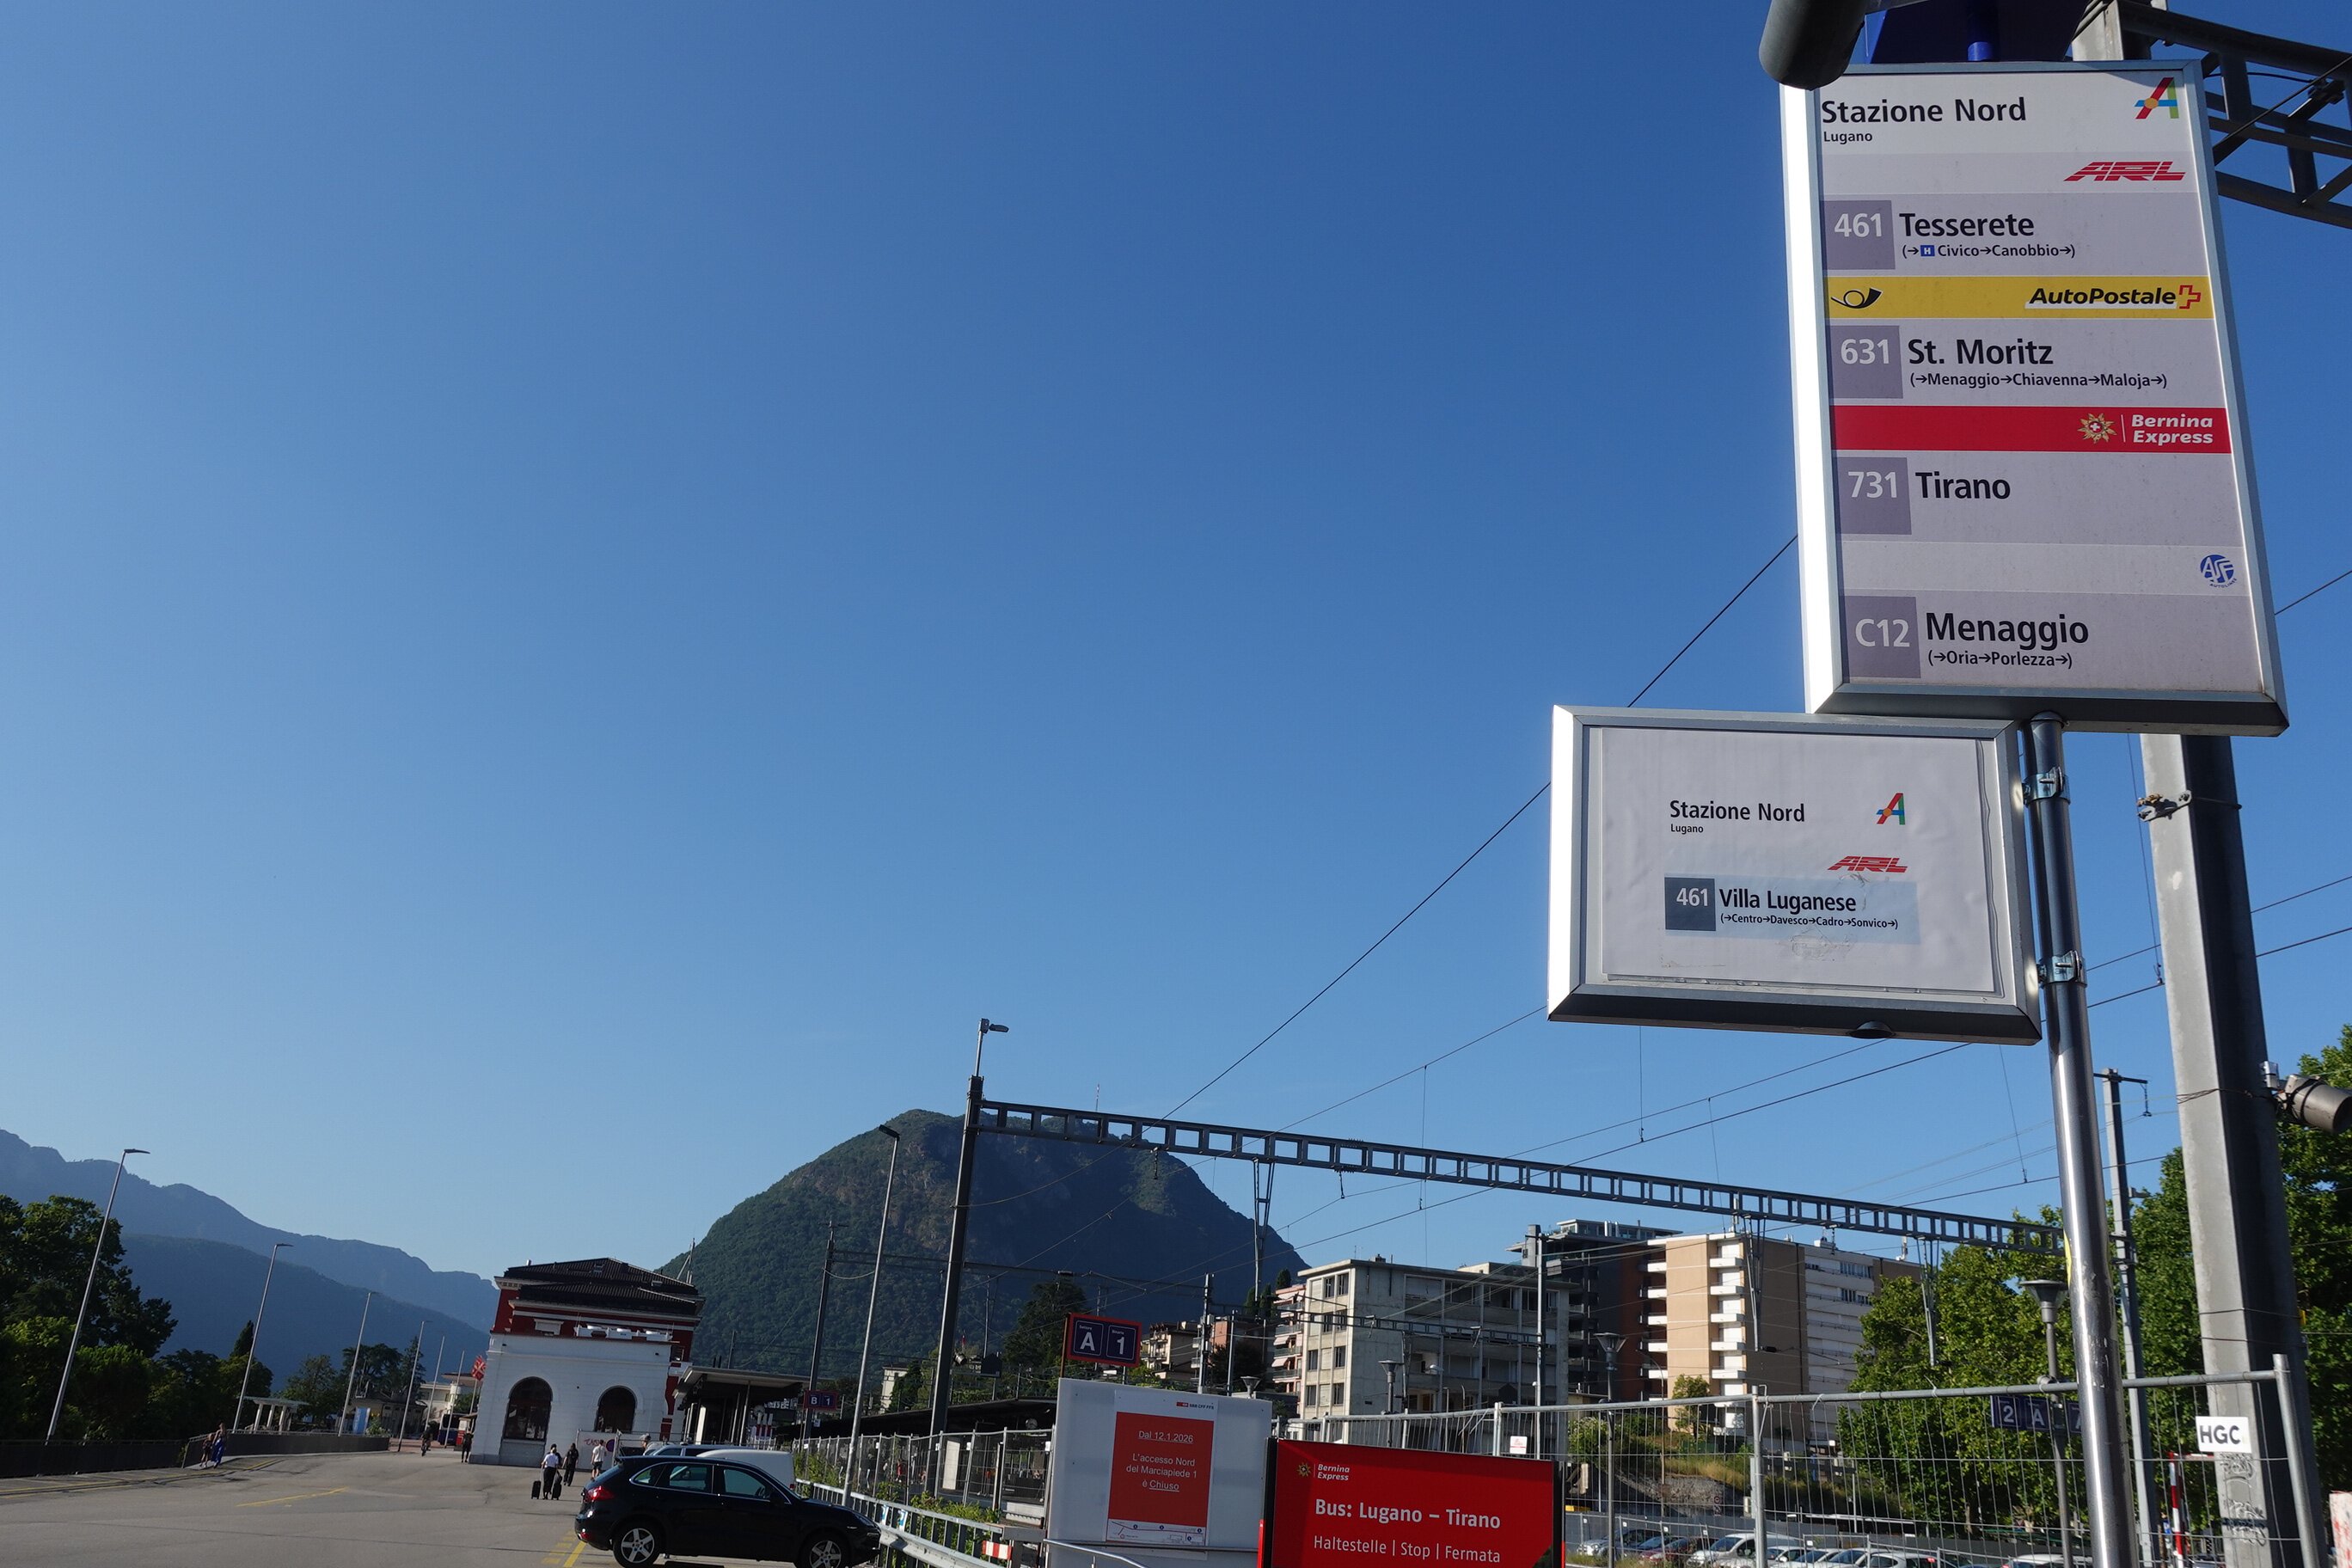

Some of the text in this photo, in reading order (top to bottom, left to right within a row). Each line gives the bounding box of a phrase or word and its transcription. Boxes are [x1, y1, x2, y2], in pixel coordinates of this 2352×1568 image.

[1822, 97, 2026, 123] Stazione Nord
[1823, 132, 1872, 144] Lugano
[2063, 162, 2186, 181] ARL
[1834, 213, 1883, 237] 461
[1899, 213, 2034, 236] Tesserete
[2029, 287, 2177, 305] AutoPostale
[1841, 339, 1890, 364] 631
[1908, 339, 2053, 364] St. Moritz
[2131, 413, 2214, 428] Bernina
[2133, 430, 2214, 445] Express
[1847, 471, 1897, 498] 731
[1915, 471, 2011, 499] Tirano
[1855, 619, 1910, 648] C12
[1926, 612, 2089, 651] Menaggio
[1670, 800, 1805, 822] Stazione Nord
[1670, 824, 1704, 835] Lugano
[1828, 855, 1908, 873] ARL
[1676, 888, 1709, 907] 461
[1719, 889, 1857, 915] Villa Luganese
[1080, 1332, 1125, 1355] A 1
[811, 1396, 818, 1405] B
[2003, 1405, 2045, 1426] 2 A
[1138, 1430, 1194, 1443] Dal 12.1.2026
[2199, 1424, 2241, 1445] HGC
[1132, 1453, 1196, 1467] L'accesso Nord
[1317, 1463, 1351, 1473] Bernina
[1141, 1466, 1191, 1479] Marciapiede
[1317, 1472, 1349, 1481] Express
[1149, 1479, 1179, 1491] Chiuso
[1315, 1498, 1352, 1518] Bus:
[1359, 1502, 1423, 1524] Lugano
[1445, 1508, 1501, 1529] Tirano
[1314, 1535, 1387, 1554] Haltestelle
[1400, 1542, 1430, 1560] Stop
[1445, 1546, 1500, 1563] Fermata
